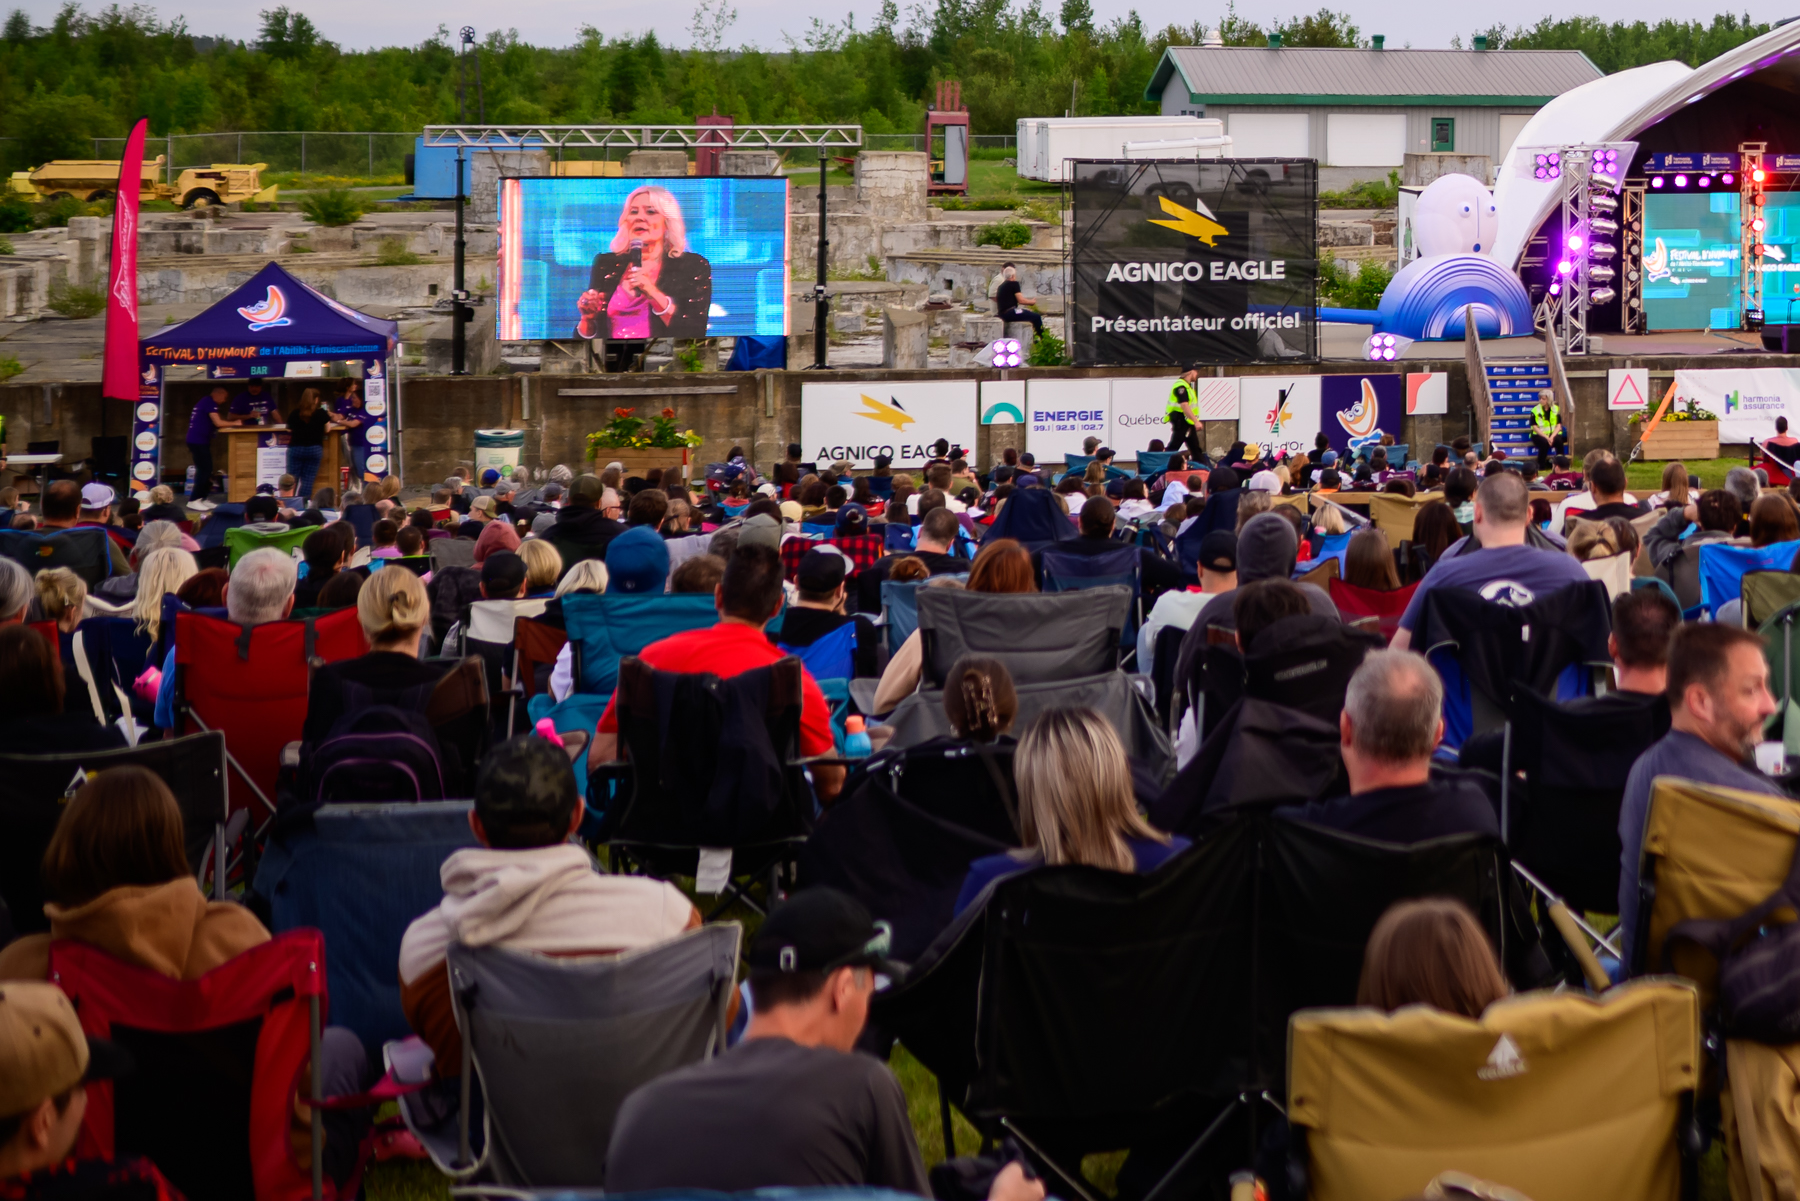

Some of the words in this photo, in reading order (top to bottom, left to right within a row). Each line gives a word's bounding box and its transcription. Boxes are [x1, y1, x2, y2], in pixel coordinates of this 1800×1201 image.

[1105, 261, 1203, 282] AGNICO
[1210, 260, 1285, 281] EAGLE
[1091, 315, 1225, 333] Présentateur
[1230, 312, 1300, 330] officiel
[197, 346, 256, 360] D'HUMOUR
[260, 347, 270, 356] de
[251, 366, 268, 375] BAR
[1743, 394, 1781, 402] harmonia
[1118, 413, 1166, 426] Québec
[816, 446, 894, 461] AGNICO
